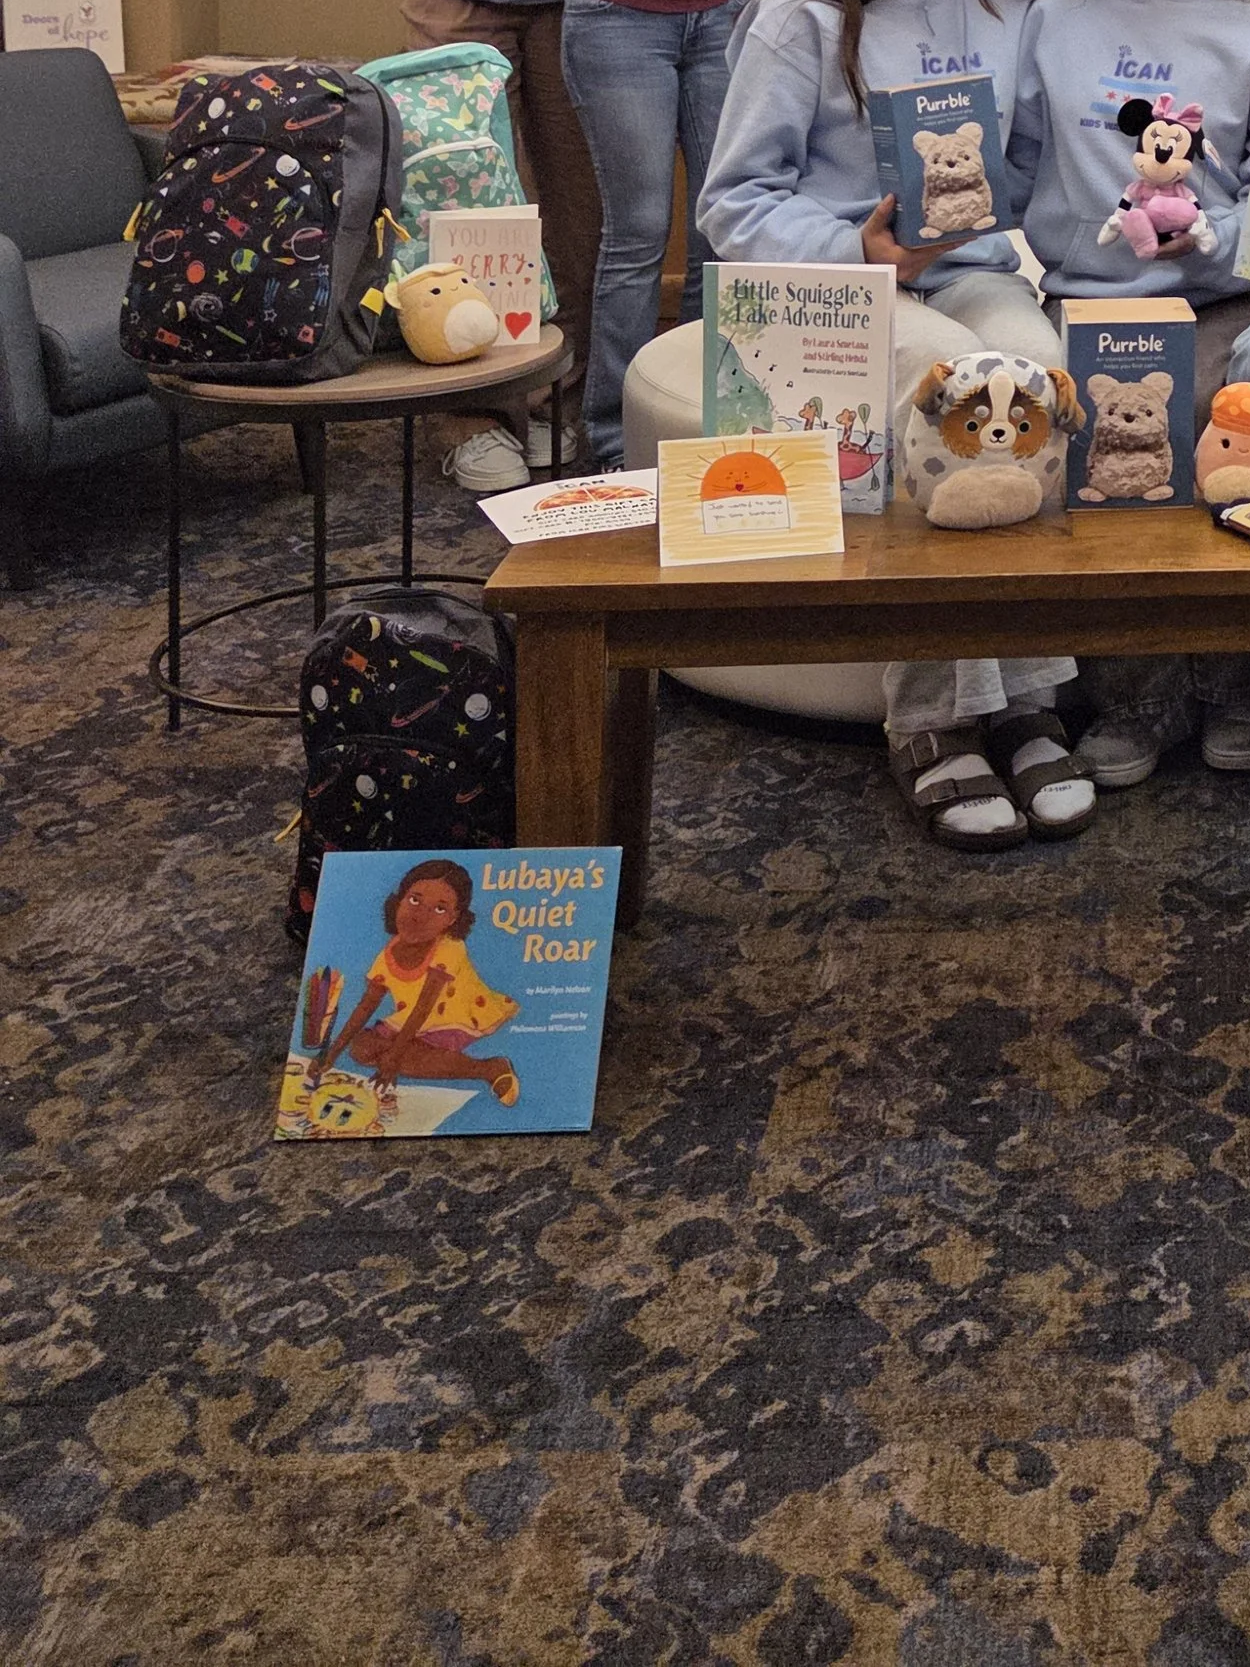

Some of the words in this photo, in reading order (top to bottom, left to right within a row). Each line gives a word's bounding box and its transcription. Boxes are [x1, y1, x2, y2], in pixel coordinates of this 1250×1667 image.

[22, 14, 60, 24] Doors
[62, 13, 109, 49] hope
[916, 92, 971, 114] Purrble
[1080, 117, 1101, 129] KIDS
[449, 227, 487, 247] YOU
[734, 278, 779, 301] Little
[785, 281, 873, 310] Squiggle's
[736, 302, 777, 325] Lake
[781, 305, 870, 329] Adventure
[802, 337, 812, 348] By
[813, 337, 835, 348] Laura
[1098, 332, 1163, 353] Purrble
[802, 351, 817, 361] and
[481, 859, 605, 898] Lubaya's
[492, 898, 577, 934] Quiet
[523, 933, 597, 963] Roar
